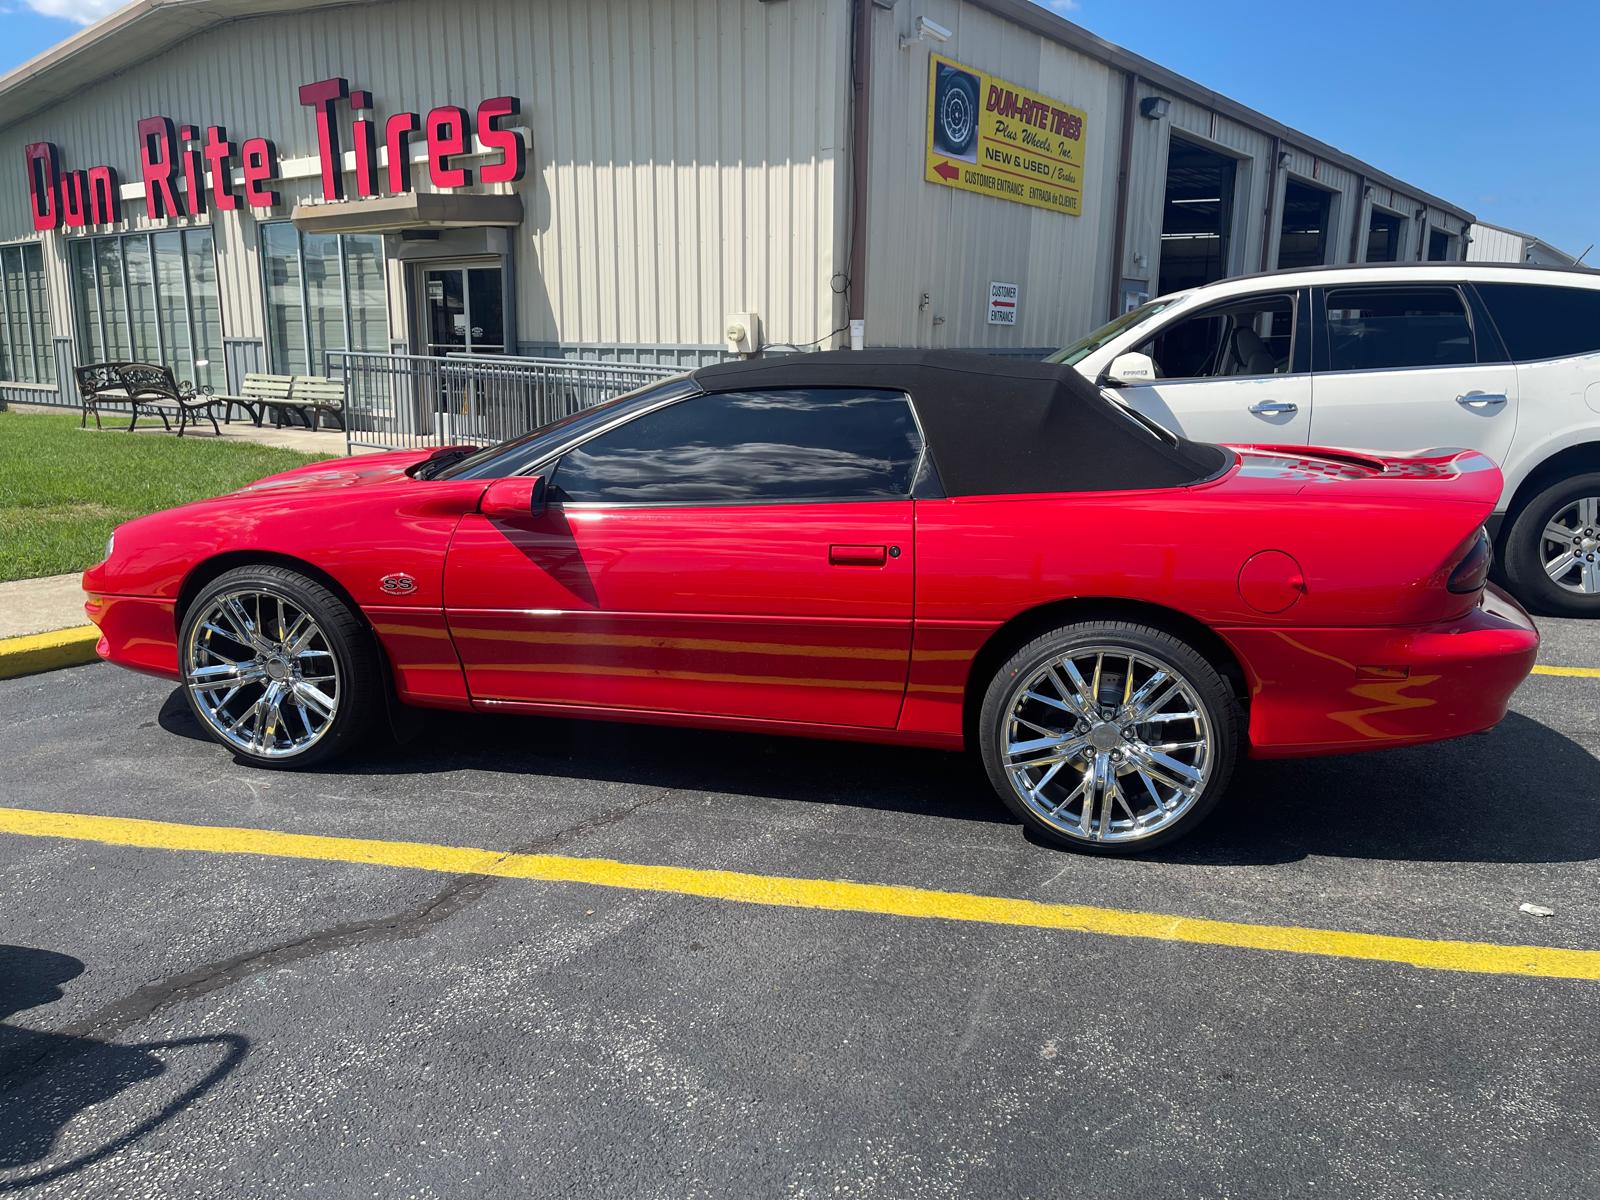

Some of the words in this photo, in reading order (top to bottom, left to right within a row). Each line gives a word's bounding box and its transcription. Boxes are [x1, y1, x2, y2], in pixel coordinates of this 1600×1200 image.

[986, 84, 1050, 129] DUN-RITE
[1050, 108, 1082, 141] TIRES
[25, 141, 122, 231] Dun
[138, 115, 280, 219] Rite
[299, 76, 525, 201] Tires
[995, 120, 1018, 141] Plus
[1058, 141, 1073, 159] Inc.
[985, 146, 1012, 164] NEW
[1014, 156, 1021, 167] &
[1023, 158, 1049, 176] USED
[964, 170, 996, 189] CUSTOMER
[996, 178, 1024, 197] ENTRANCE
[1029, 186, 1052, 203] ENTRADA
[1058, 194, 1077, 209] CLIENTE
[992, 285, 1016, 298] CUSTOMER
[991, 310, 1014, 322] ENTRANCE
[383, 577, 413, 590] SS
